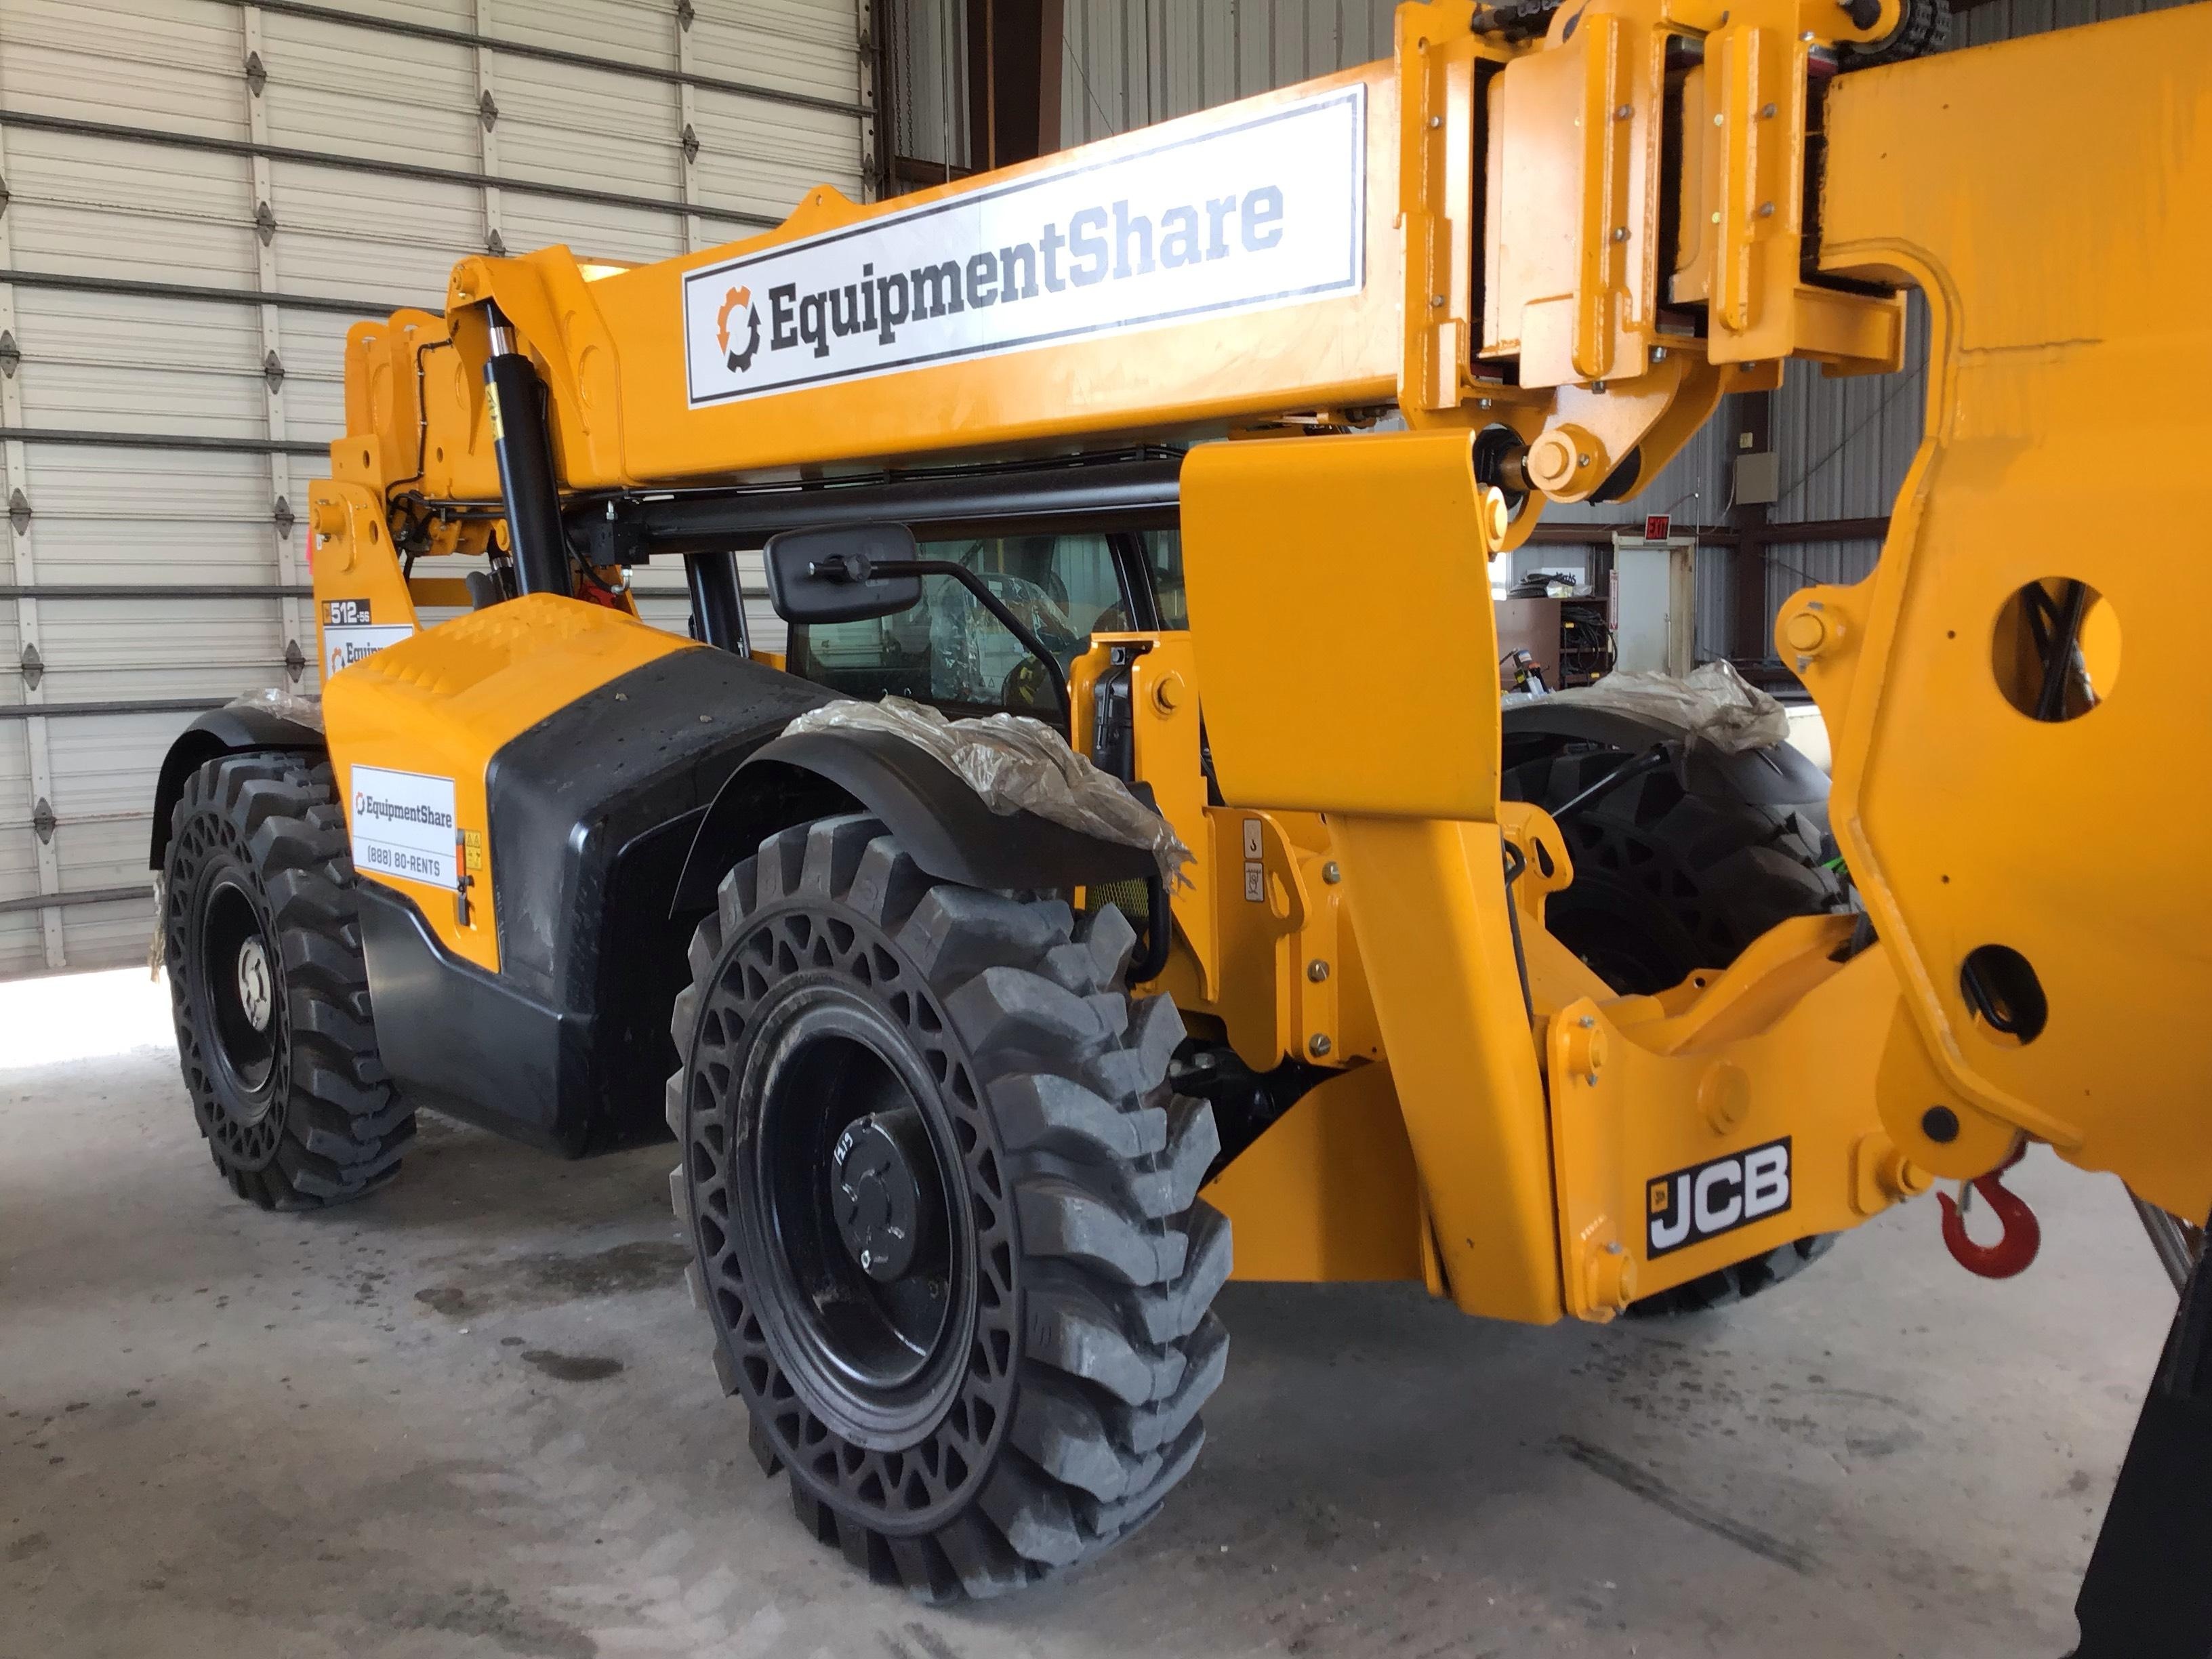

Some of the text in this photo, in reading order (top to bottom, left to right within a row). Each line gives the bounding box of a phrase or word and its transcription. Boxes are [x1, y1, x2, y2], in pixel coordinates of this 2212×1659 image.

[769, 184, 1284, 358] EquipmentShare
[331, 601, 369, 623] 512-56
[367, 796, 452, 828] EquipmentShare
[368, 845, 440, 877] (888) 80-RENTS
[1651, 1145, 1789, 1249] JCB
